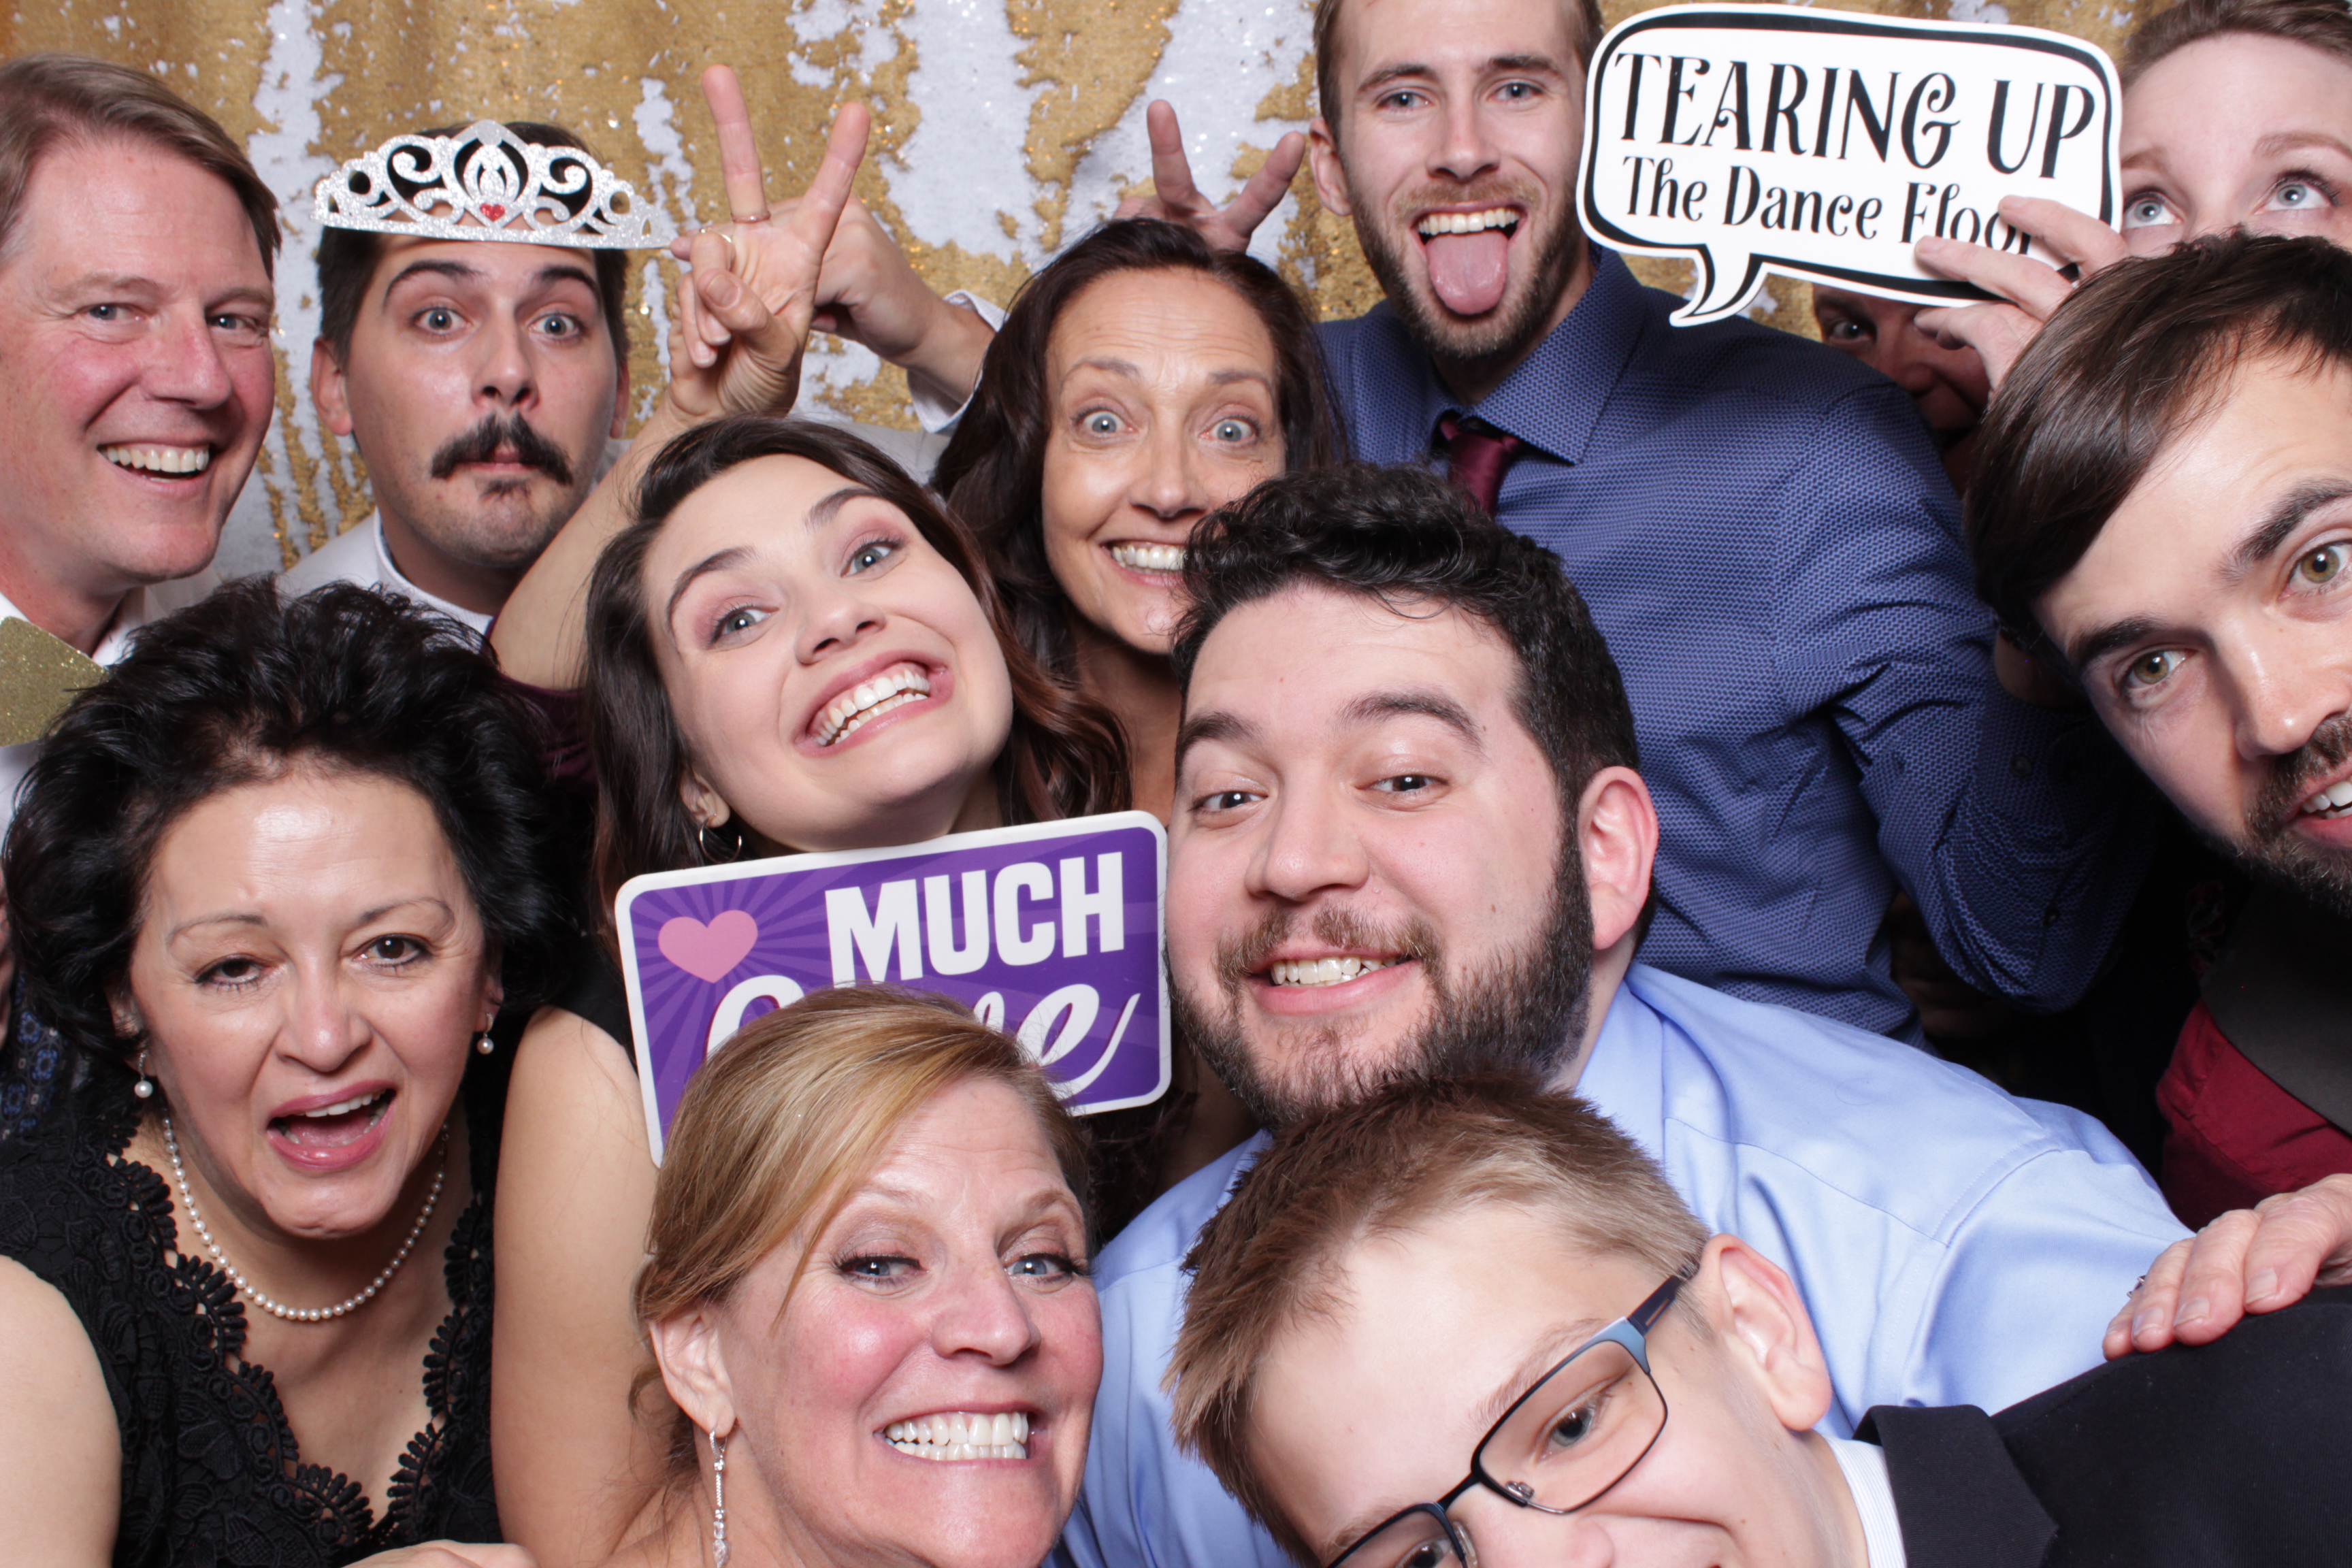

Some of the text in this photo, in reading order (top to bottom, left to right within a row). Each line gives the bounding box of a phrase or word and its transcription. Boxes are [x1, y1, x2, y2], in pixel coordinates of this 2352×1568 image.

[1614, 53, 2095, 178] TEARING UP
[1622, 156, 1708, 221] The
[1722, 165, 1883, 240] Dance
[825, 851, 1125, 987] MUCH
